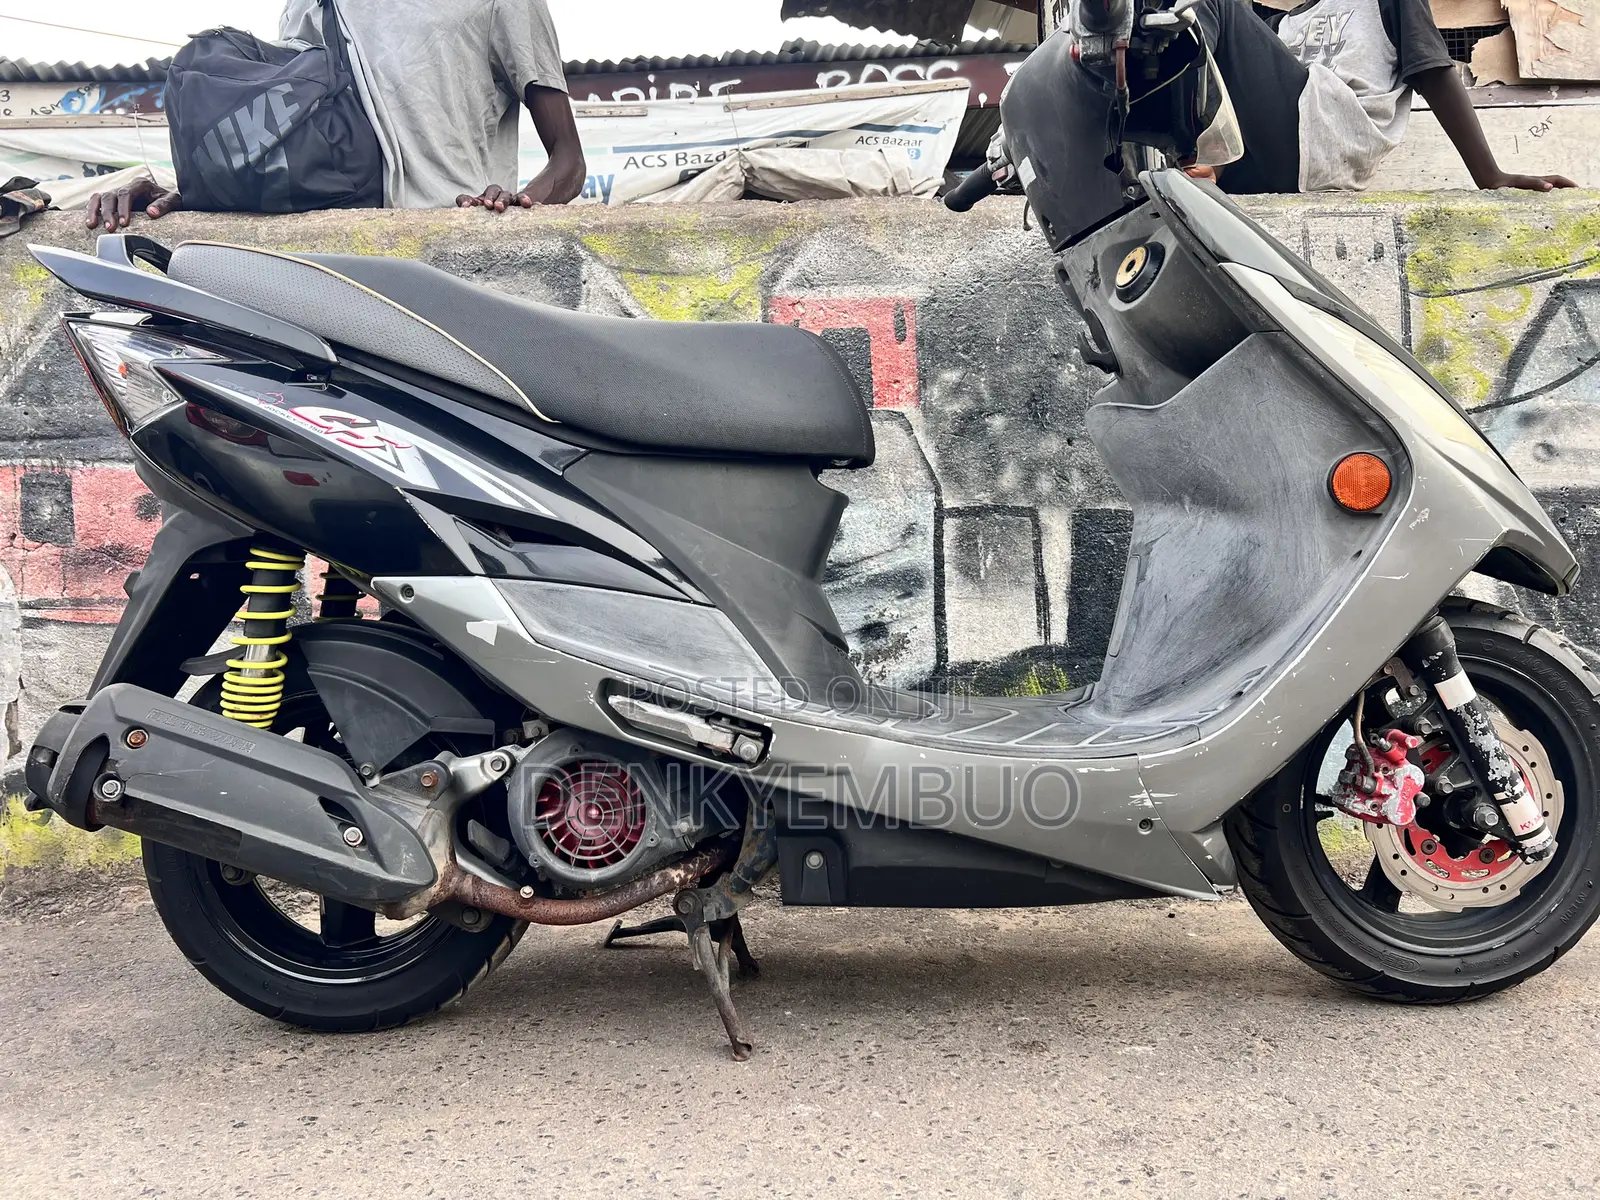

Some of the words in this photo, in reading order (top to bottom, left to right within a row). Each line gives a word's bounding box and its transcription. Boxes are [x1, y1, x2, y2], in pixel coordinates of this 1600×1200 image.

[855, 135, 879, 146] ACS
[882, 136, 924, 147] Bazaar
[623, 153, 668, 170] ACS
